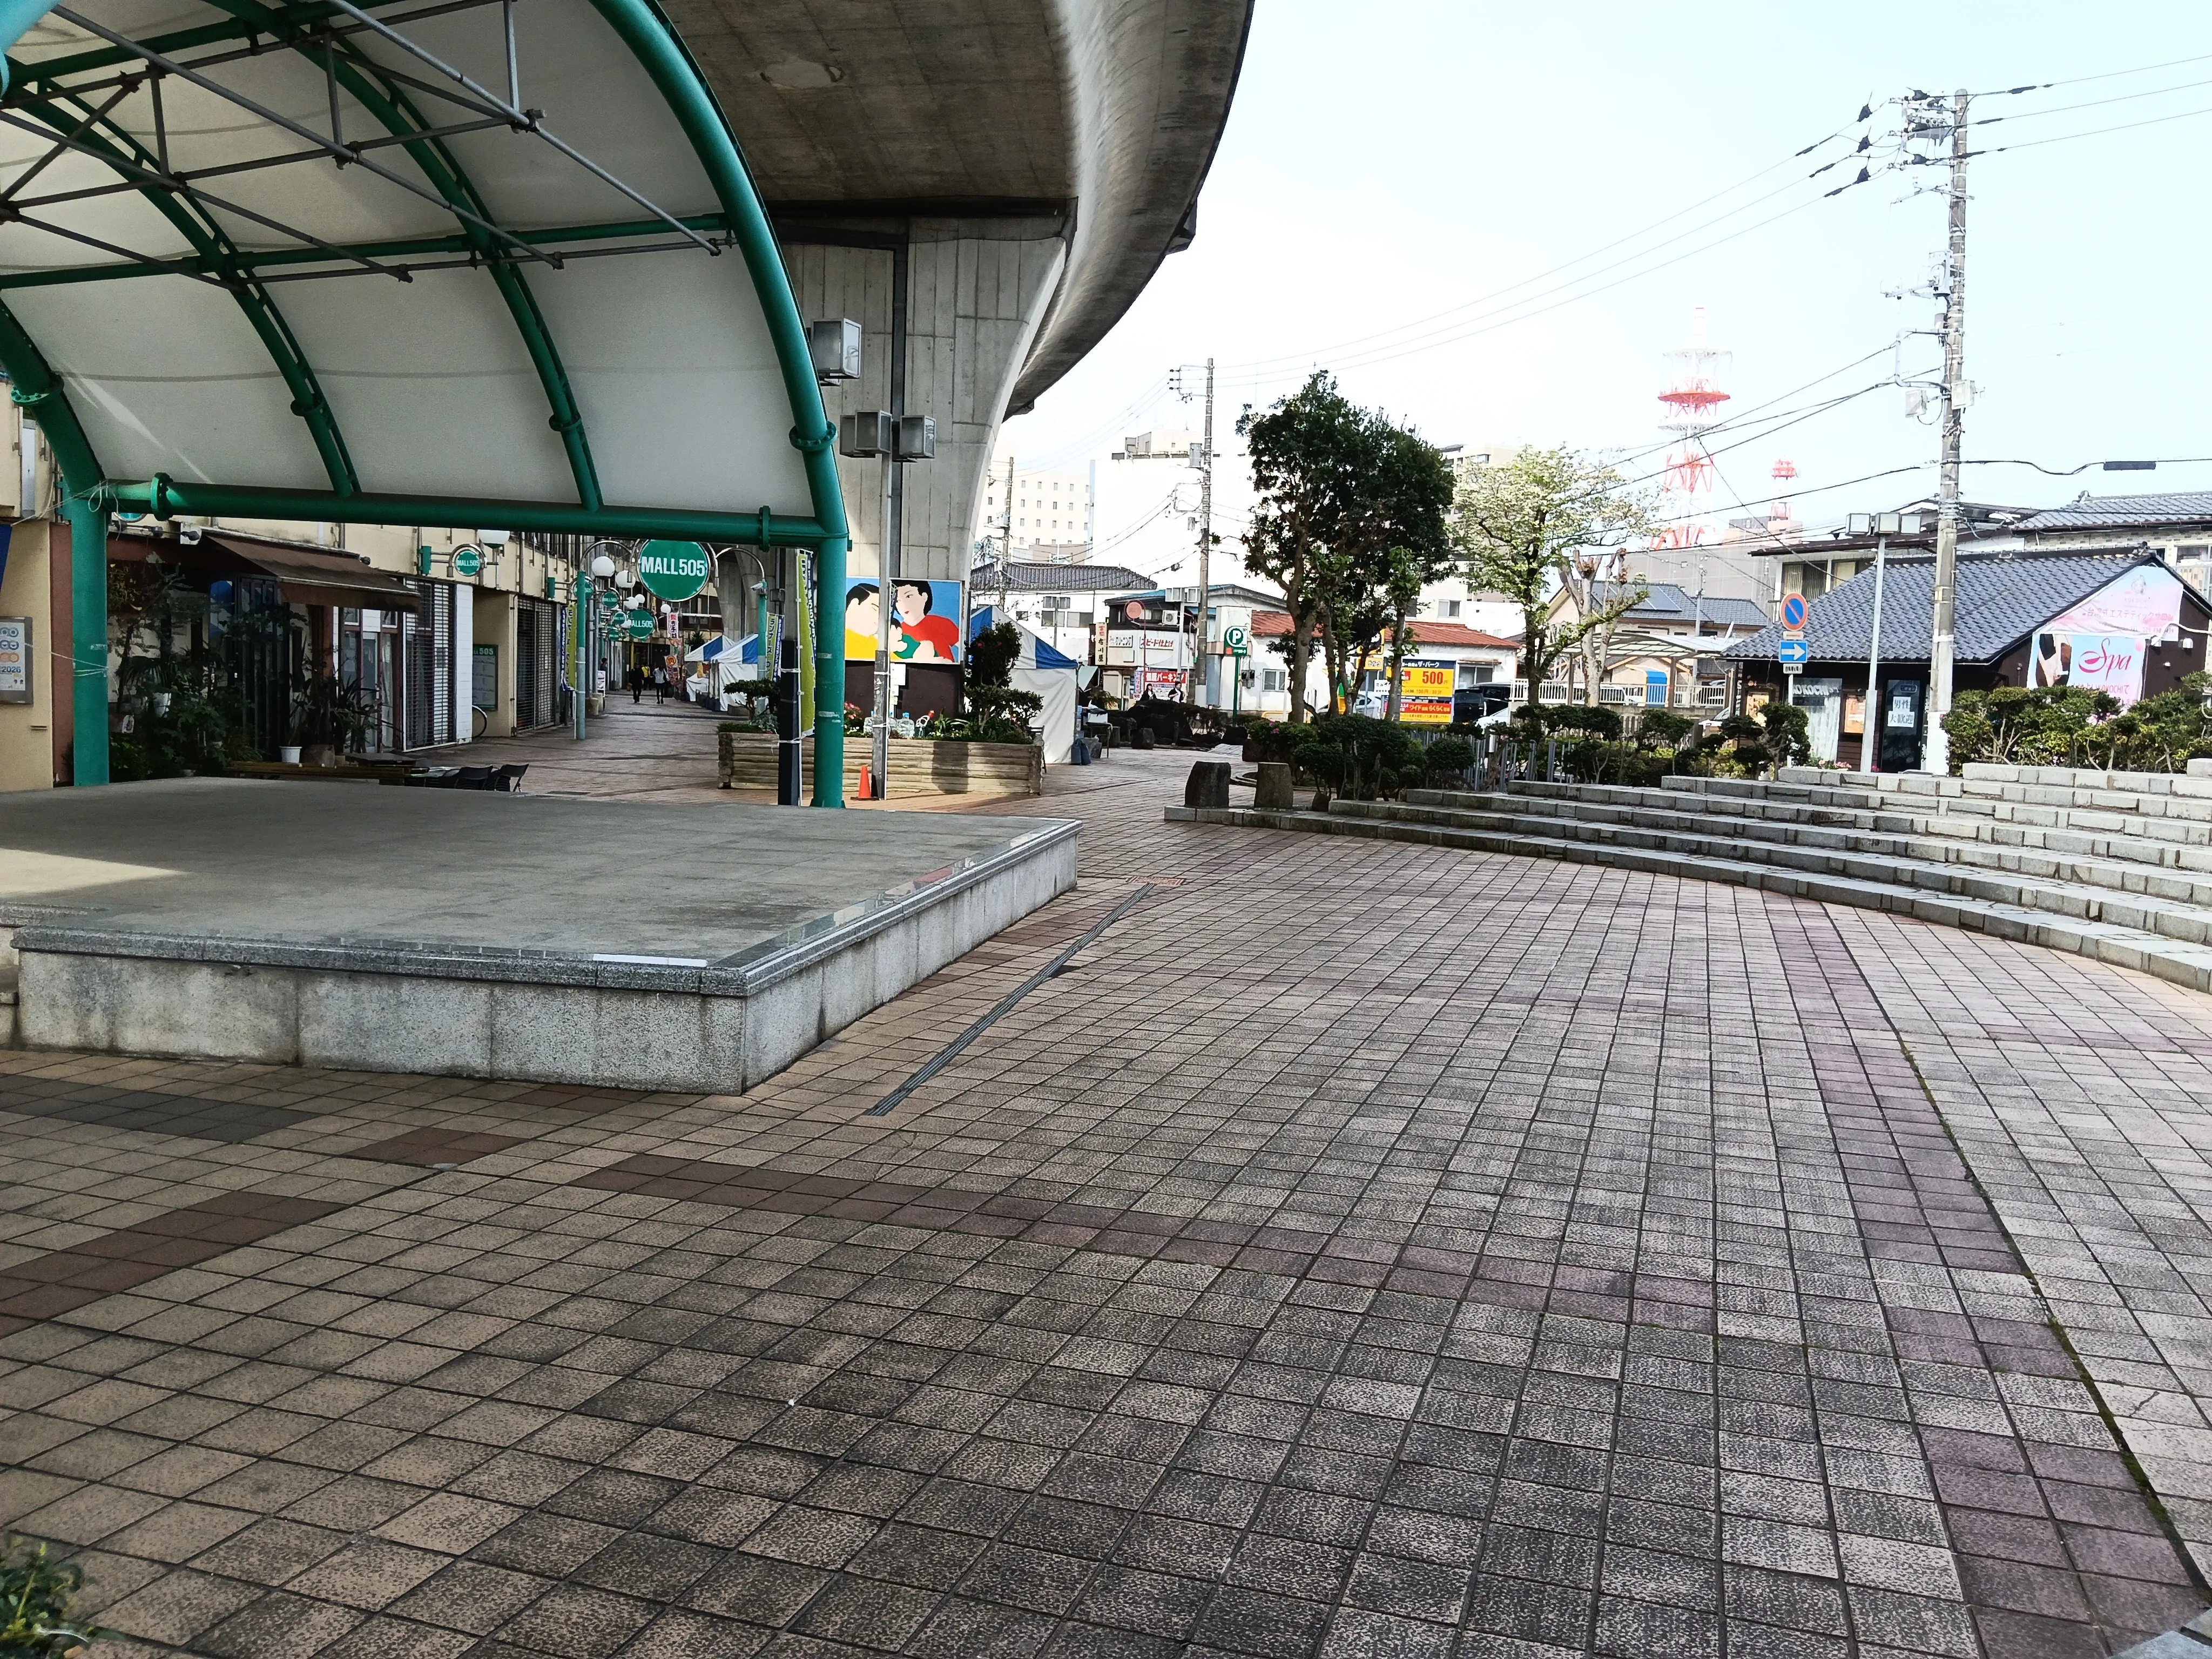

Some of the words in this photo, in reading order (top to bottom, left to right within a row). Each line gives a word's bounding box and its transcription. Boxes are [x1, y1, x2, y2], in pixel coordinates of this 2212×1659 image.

[641, 556, 705, 576] MALL505
[1232, 630, 1242, 644] P
[2078, 637, 2132, 681] Spa
[1894, 699, 1909, 709] 男性
